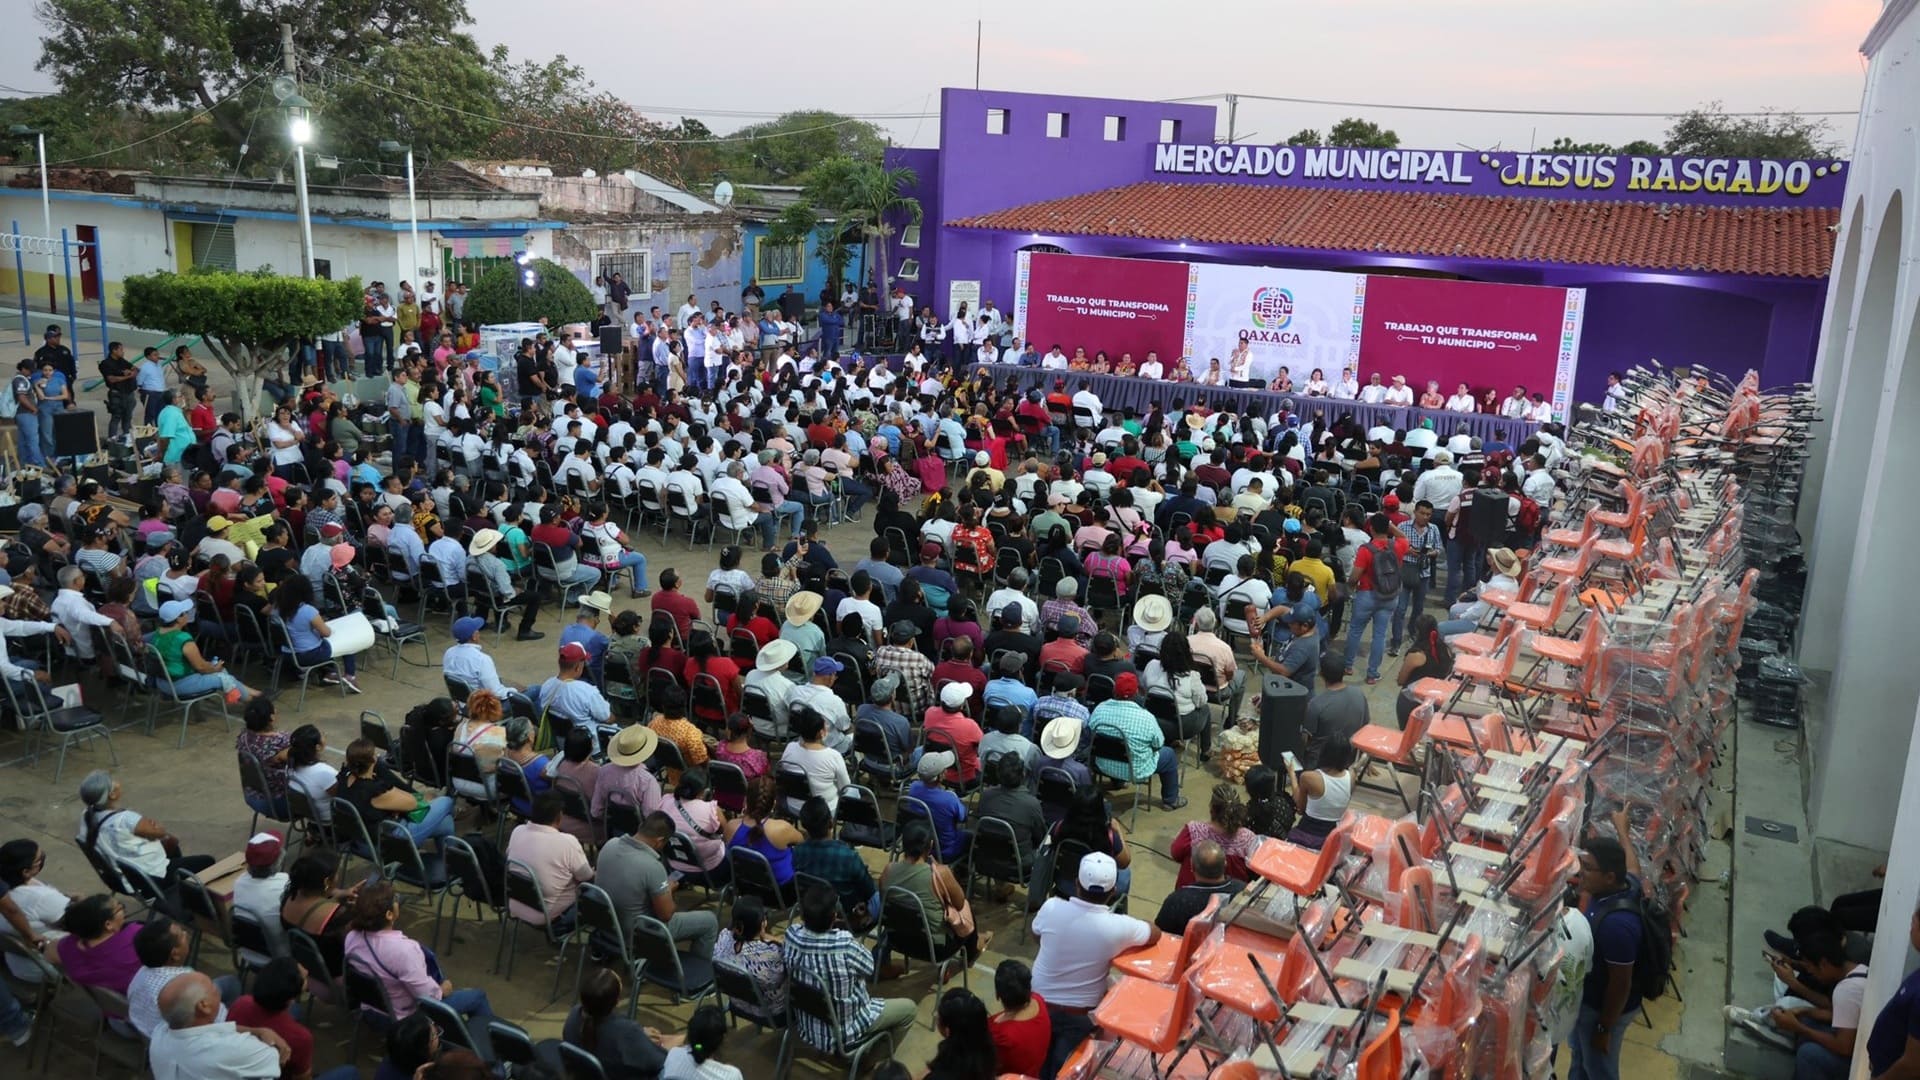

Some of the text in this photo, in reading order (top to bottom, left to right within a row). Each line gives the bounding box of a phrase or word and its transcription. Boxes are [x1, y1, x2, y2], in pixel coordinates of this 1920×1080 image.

[1154, 144, 1811, 195] MERCADO MUNICIPAL JESUS RASGADO
[1046, 294, 1169, 312] TRABAJO QUE TRANSFORMA
[1076, 307, 1136, 319] TU MUNICIPIO
[1238, 329, 1302, 345] OAXACA
[1384, 321, 1538, 342] TRABAJO QUE TRANSFORMA
[1421, 335, 1496, 350] TU MUNICIPIO
